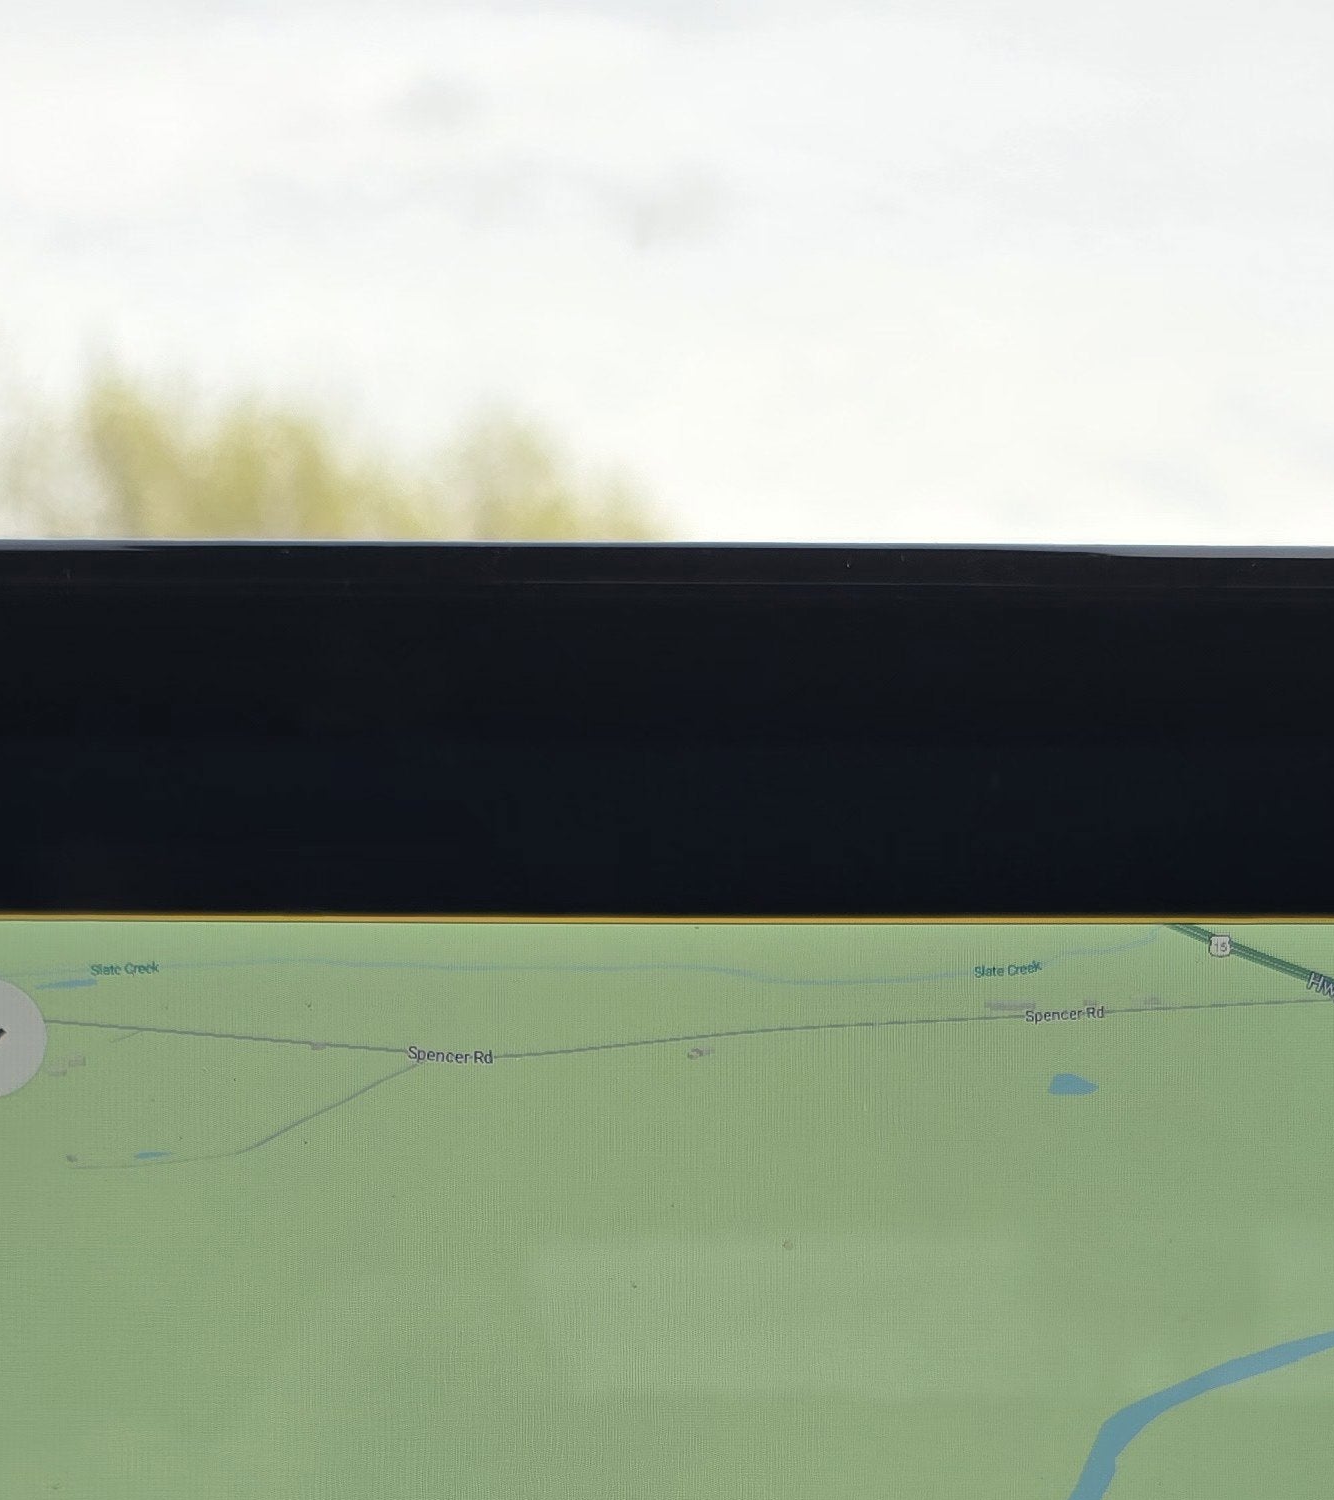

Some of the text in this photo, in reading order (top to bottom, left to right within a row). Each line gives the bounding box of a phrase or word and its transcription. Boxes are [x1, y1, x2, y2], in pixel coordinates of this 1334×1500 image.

[124, 961, 160, 976] Creek
[974, 959, 1042, 979] Slate Creek
[1025, 1005, 1106, 1025] Spencer Rd
[407, 1045, 494, 1065] Spencer Rd
